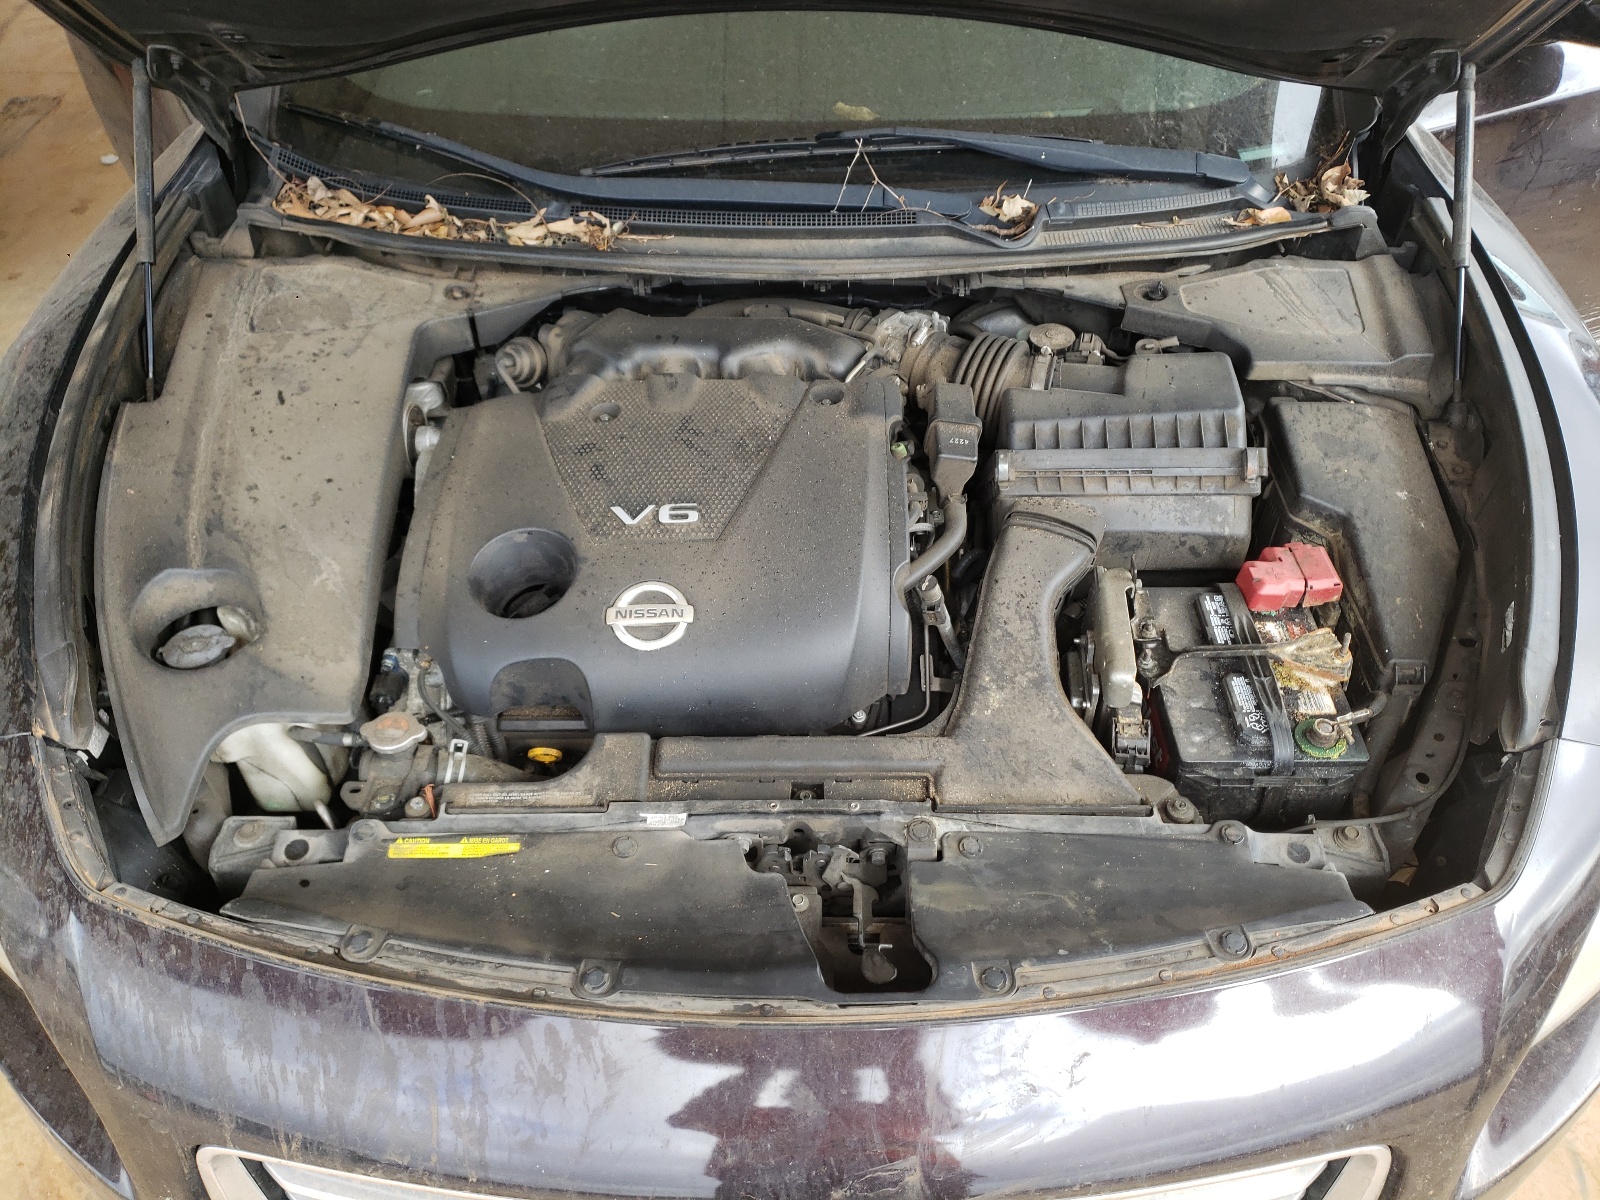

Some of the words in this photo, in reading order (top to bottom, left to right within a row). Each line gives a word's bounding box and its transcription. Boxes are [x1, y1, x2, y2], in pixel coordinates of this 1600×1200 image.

[610, 503, 699, 525] V6
[615, 608, 684, 620] NISSAN
[404, 836, 431, 844] CAUTION
